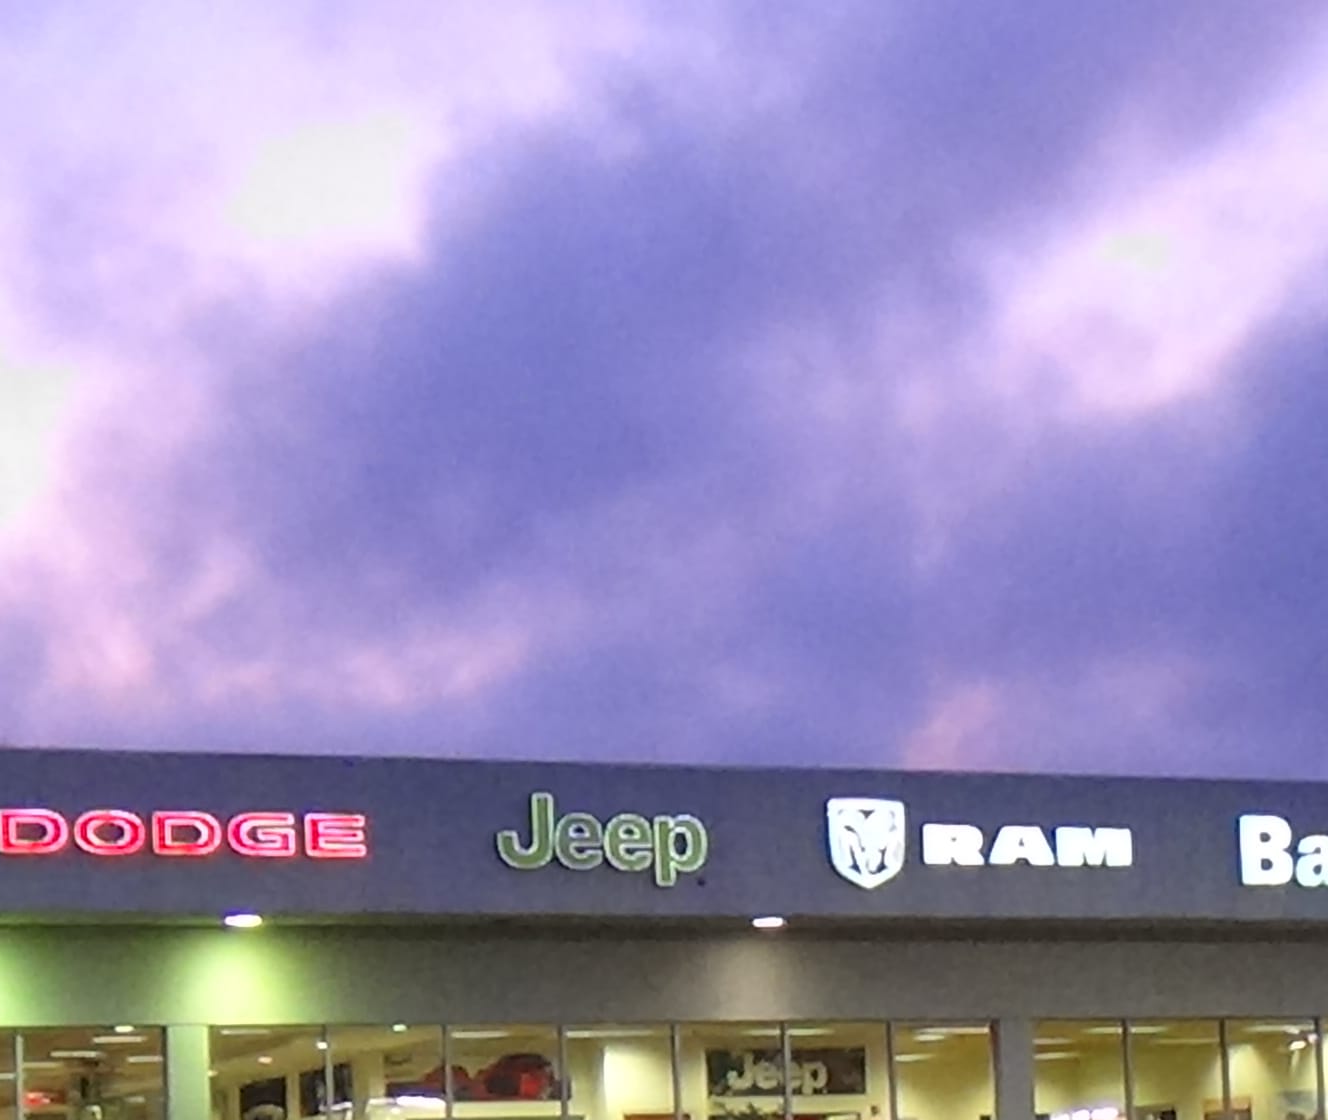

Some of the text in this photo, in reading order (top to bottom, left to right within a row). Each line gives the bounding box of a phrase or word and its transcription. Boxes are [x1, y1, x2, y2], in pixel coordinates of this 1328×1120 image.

[497, 793, 707, 886] Jeep
[922, 823, 1133, 867] RAM
[727, 1051, 828, 1095] Jeep
